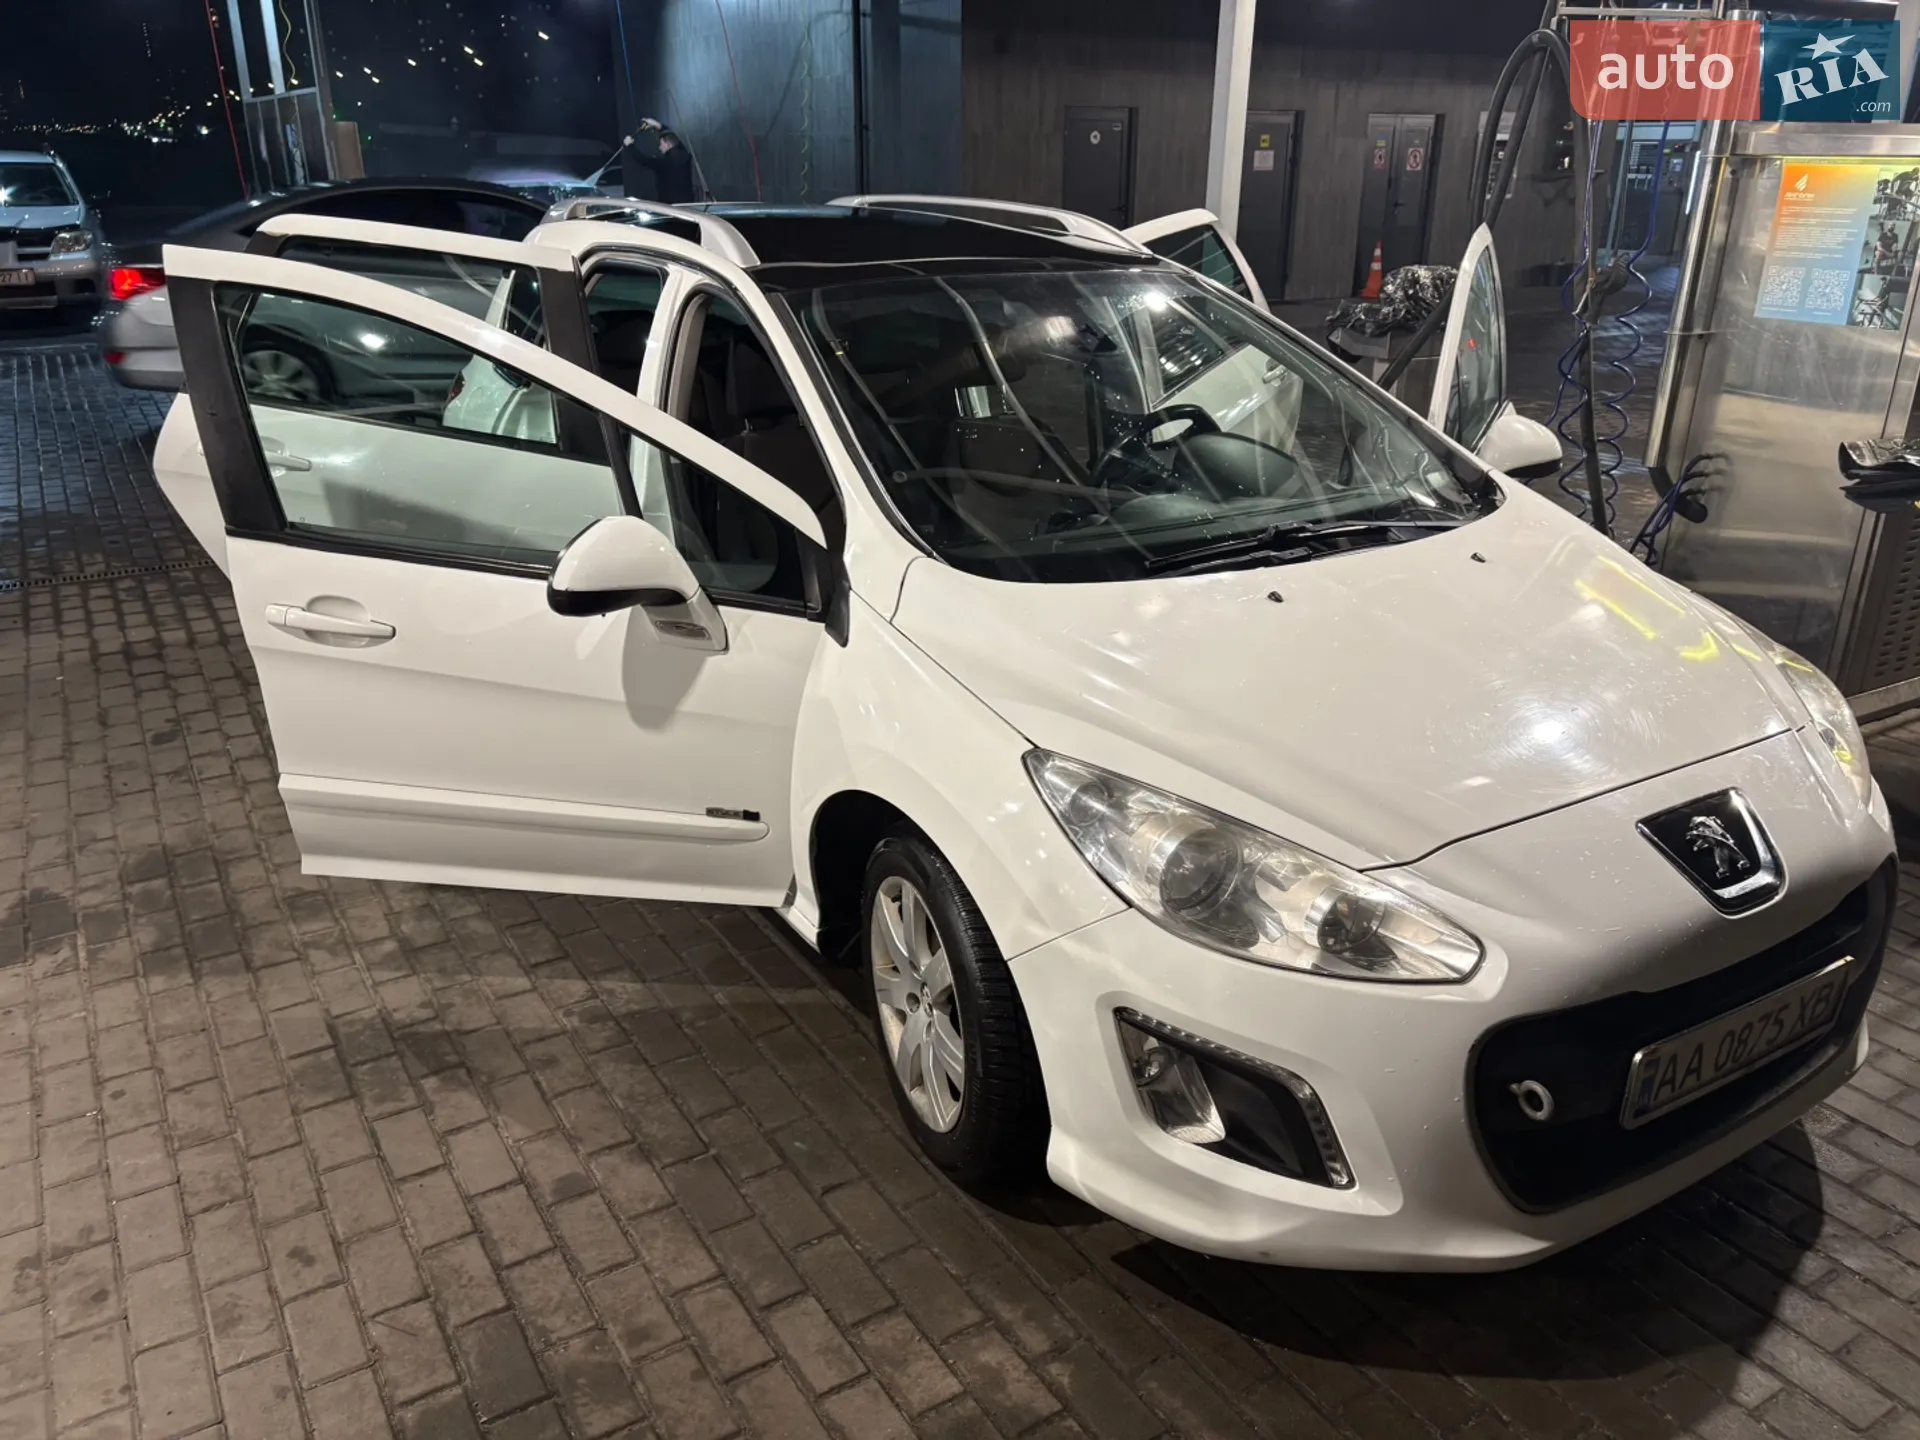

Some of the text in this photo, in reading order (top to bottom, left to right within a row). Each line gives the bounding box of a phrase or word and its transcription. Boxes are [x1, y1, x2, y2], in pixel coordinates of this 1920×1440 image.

[1653, 981, 1834, 1101] AA 0875 XB
